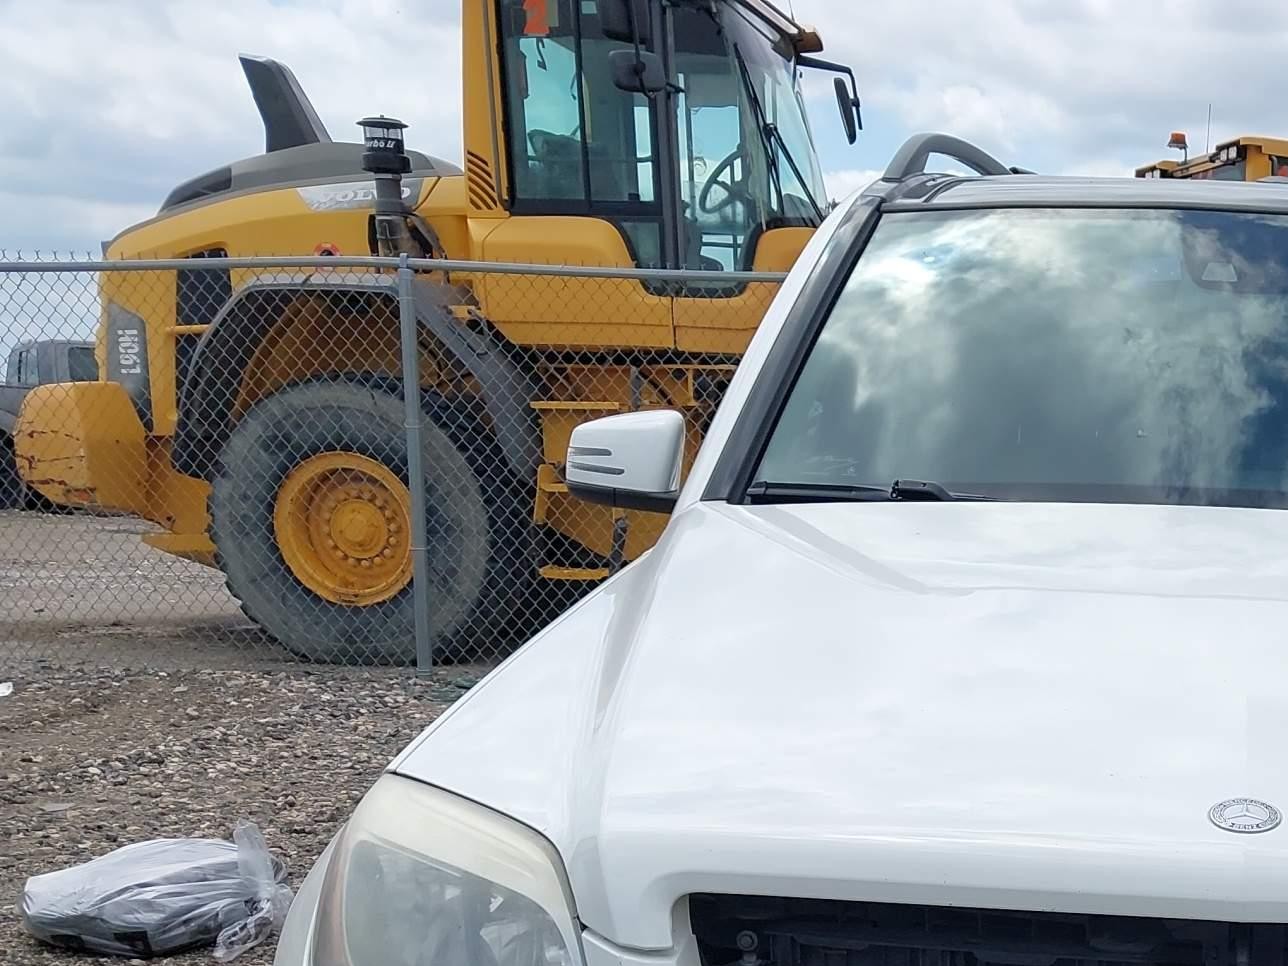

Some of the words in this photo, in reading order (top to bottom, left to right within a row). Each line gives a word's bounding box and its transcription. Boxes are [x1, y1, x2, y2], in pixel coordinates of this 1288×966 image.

[366, 139, 385, 148] urbo
[319, 187, 411, 202] VOLO
[116, 329, 141, 374] L90H
